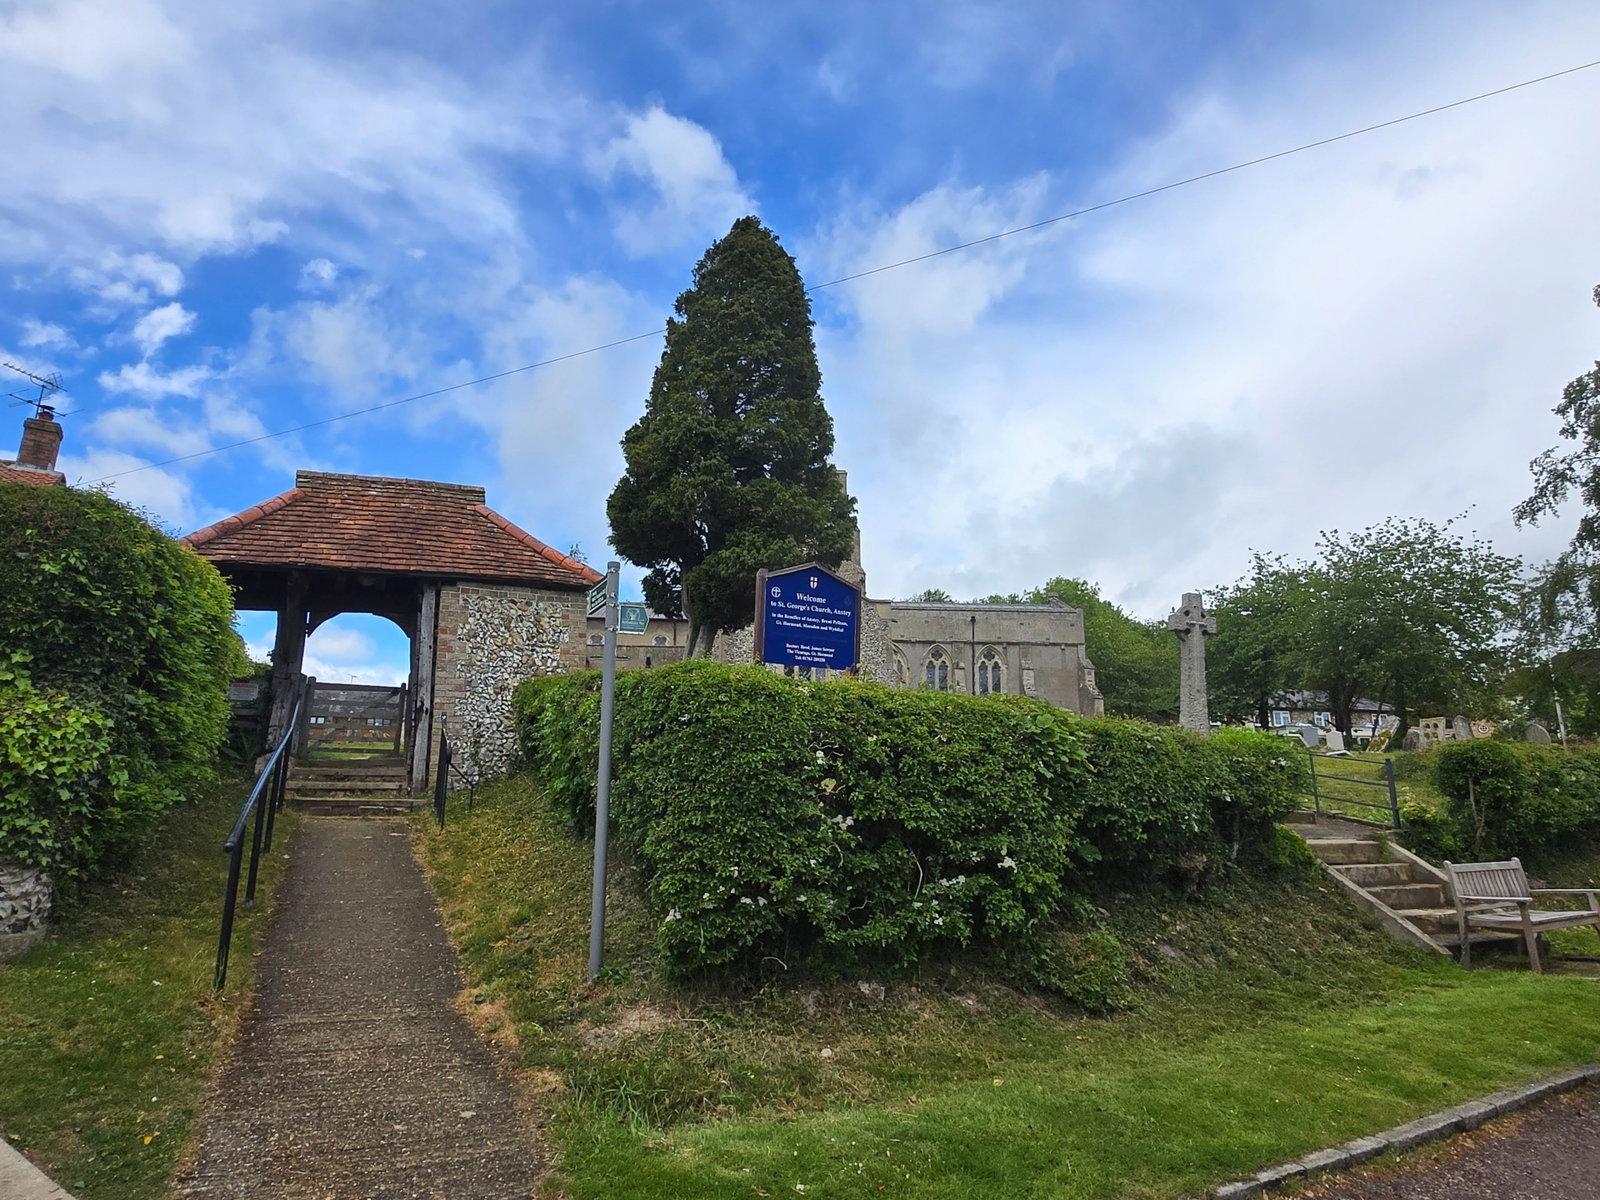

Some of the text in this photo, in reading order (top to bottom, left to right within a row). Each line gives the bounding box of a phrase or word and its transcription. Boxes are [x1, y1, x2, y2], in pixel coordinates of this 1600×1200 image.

[797, 593, 826, 603] Welcome
[787, 602, 809, 611] George's
[811, 606, 832, 614] Church,
